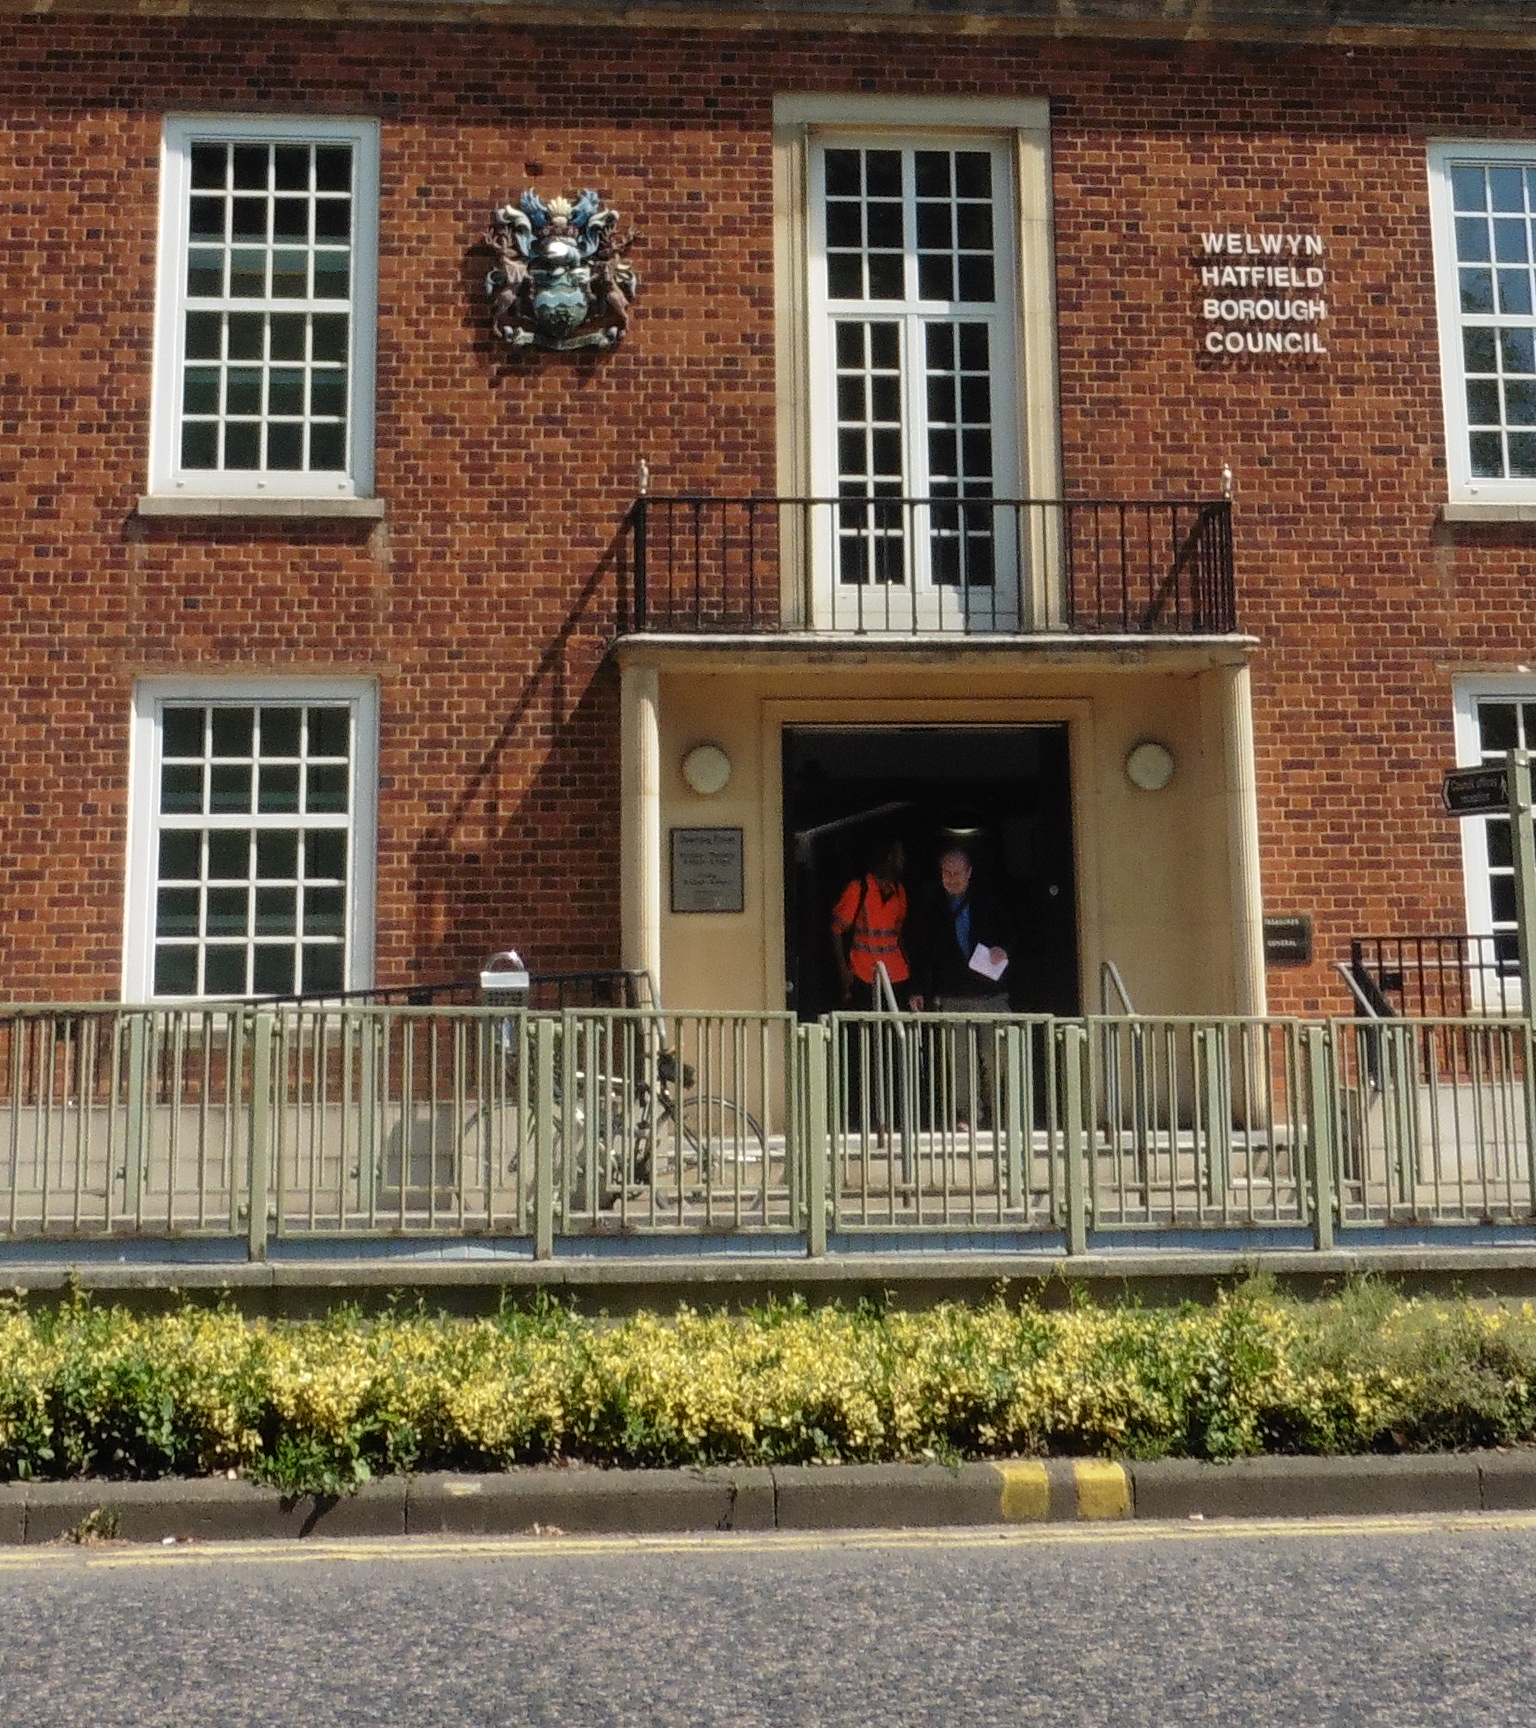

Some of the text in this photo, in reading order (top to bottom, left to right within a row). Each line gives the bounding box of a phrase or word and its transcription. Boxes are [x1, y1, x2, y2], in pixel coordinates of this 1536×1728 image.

[1201, 232, 1323, 255] WELWYN
[1201, 265, 1324, 288] HATFIELD
[1203, 299, 1326, 321] BOROUGH
[1205, 331, 1327, 354] COUNCIL
